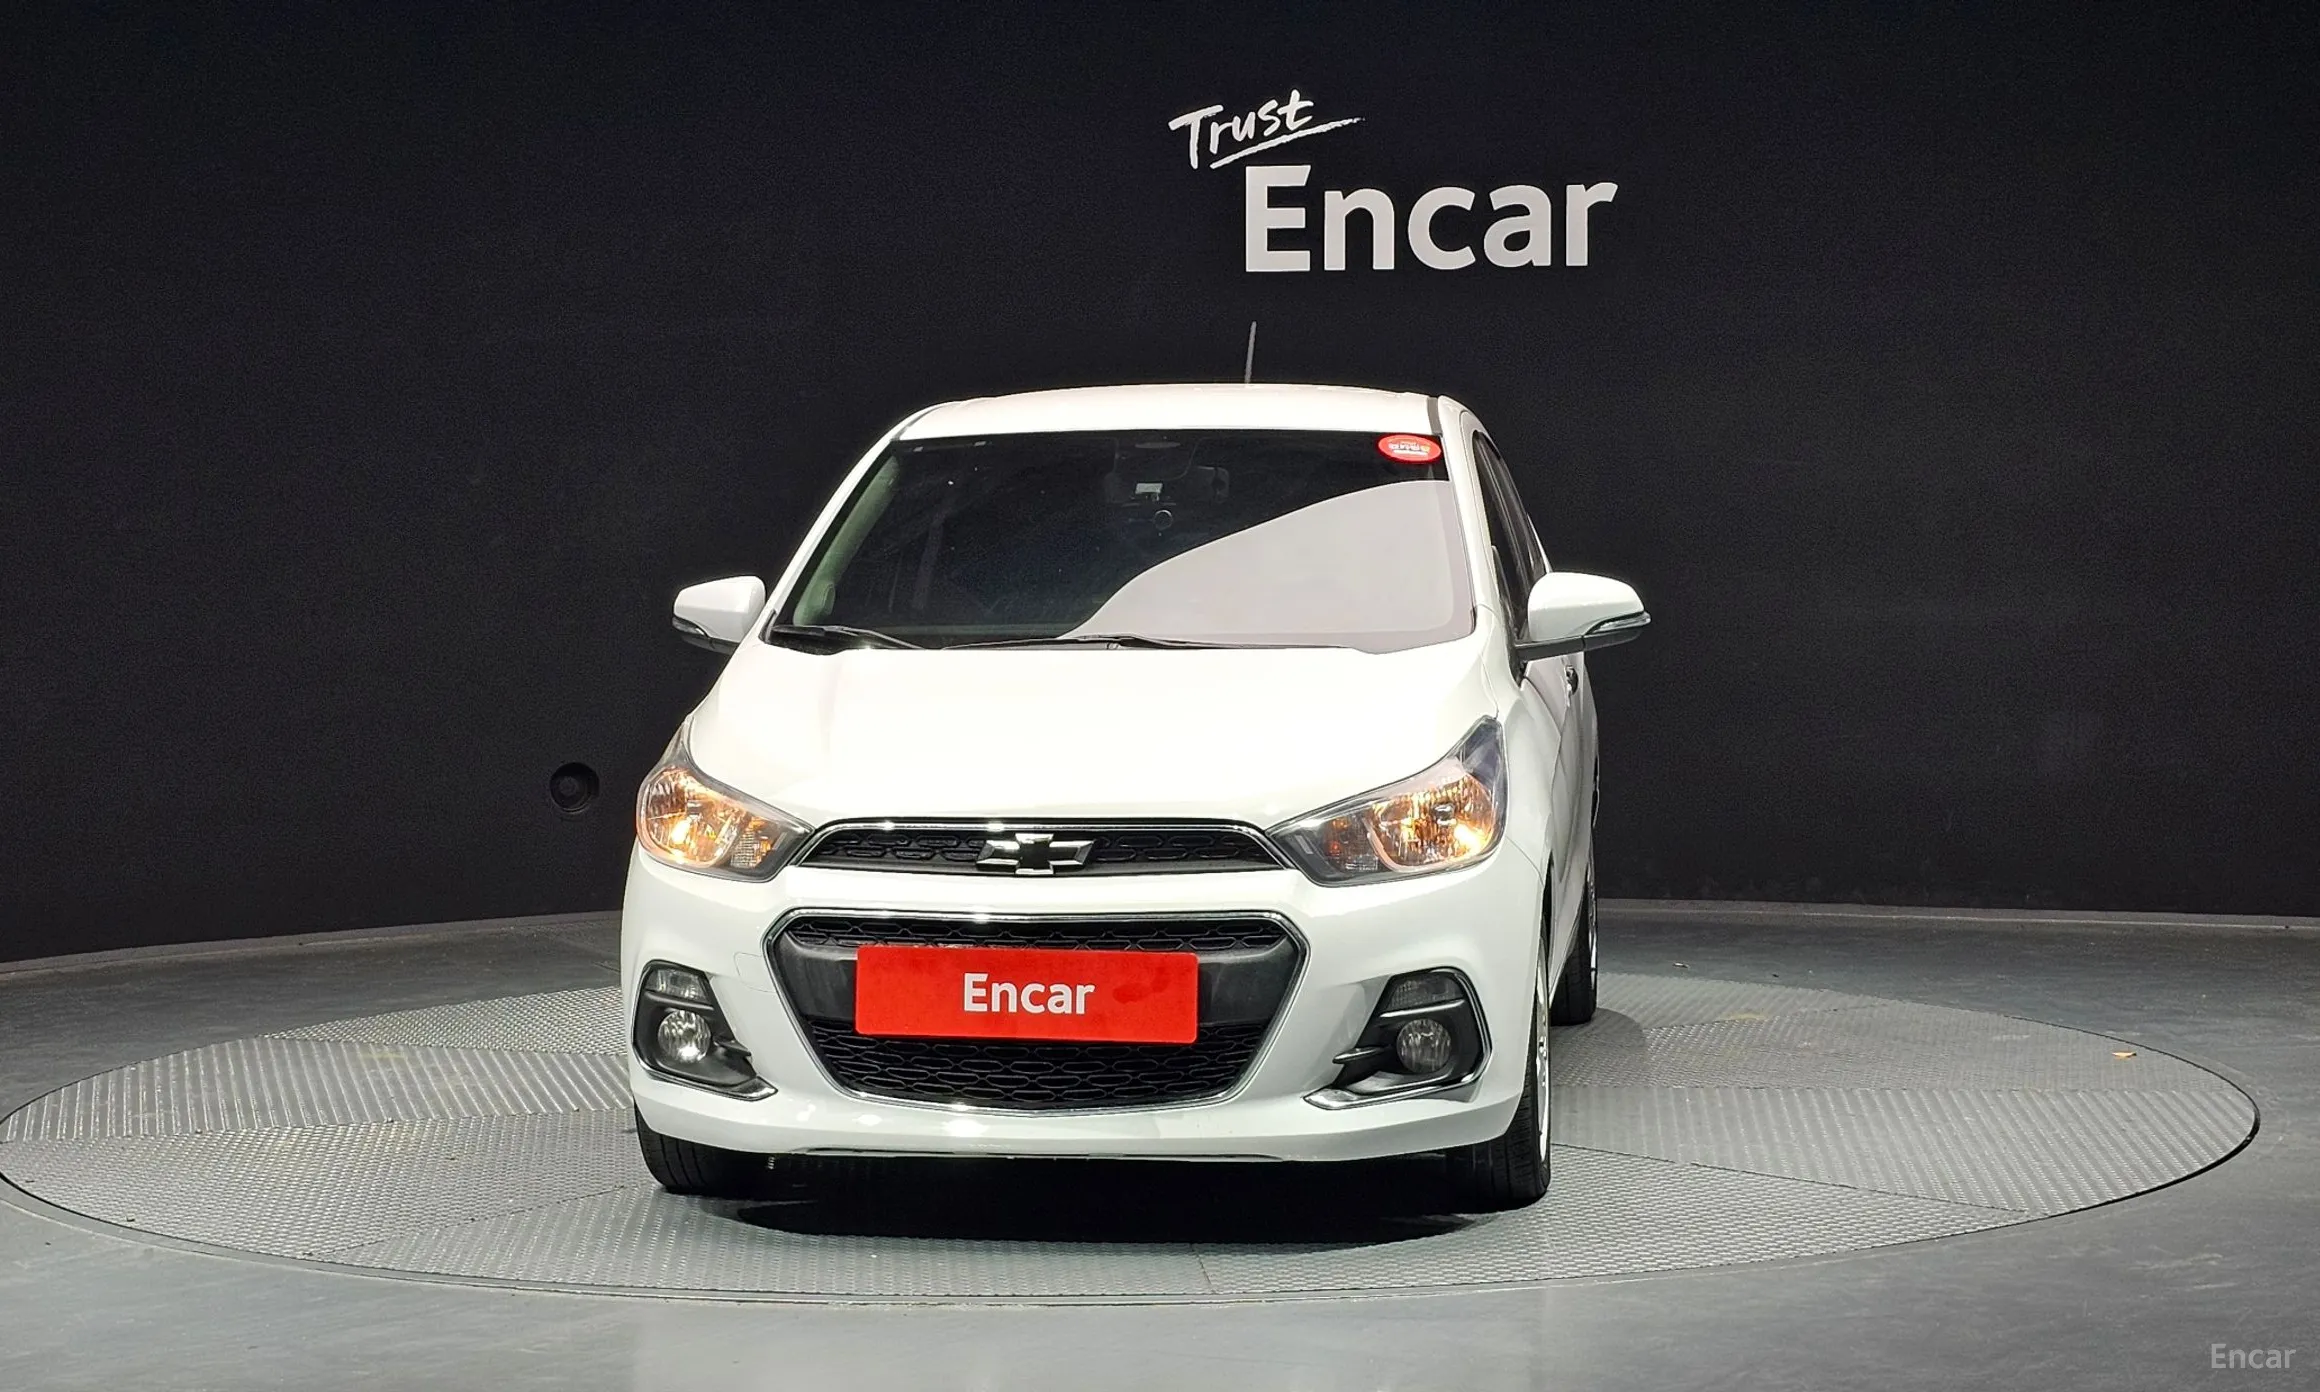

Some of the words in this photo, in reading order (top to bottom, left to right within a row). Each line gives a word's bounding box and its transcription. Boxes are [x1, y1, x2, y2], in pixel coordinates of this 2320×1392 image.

[1168, 88, 1314, 169] Trust
[1244, 164, 1619, 273] Encar
[963, 972, 1095, 1015] Encar
